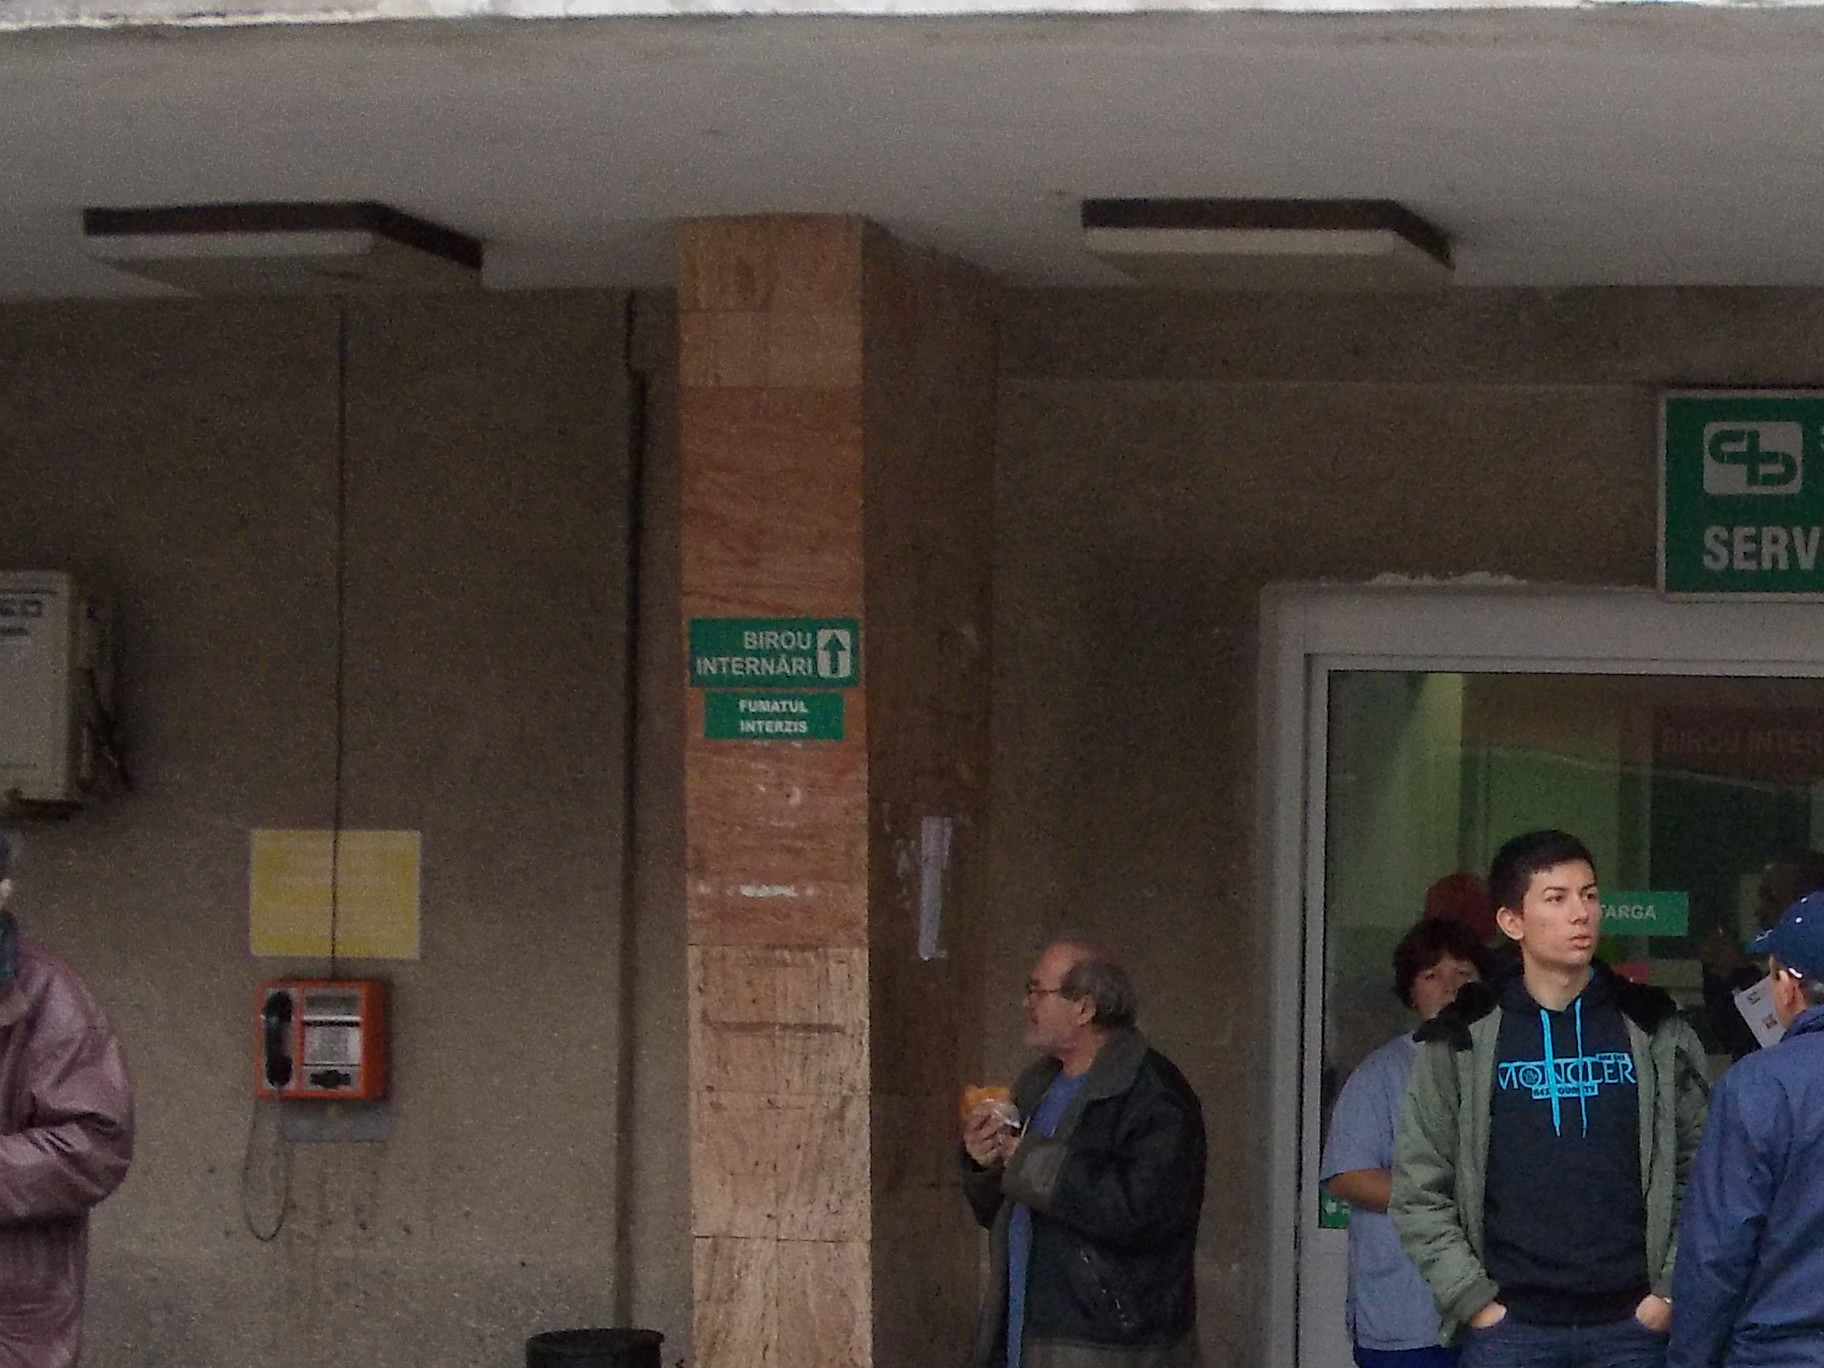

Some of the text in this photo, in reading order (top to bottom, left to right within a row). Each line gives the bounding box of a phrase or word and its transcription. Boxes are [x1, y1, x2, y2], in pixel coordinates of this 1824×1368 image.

[743, 630, 812, 650] BIROU
[696, 654, 813, 676] INTERNĂRI
[739, 699, 808, 713] FUMATUL
[740, 720, 808, 733] INTERZIS
